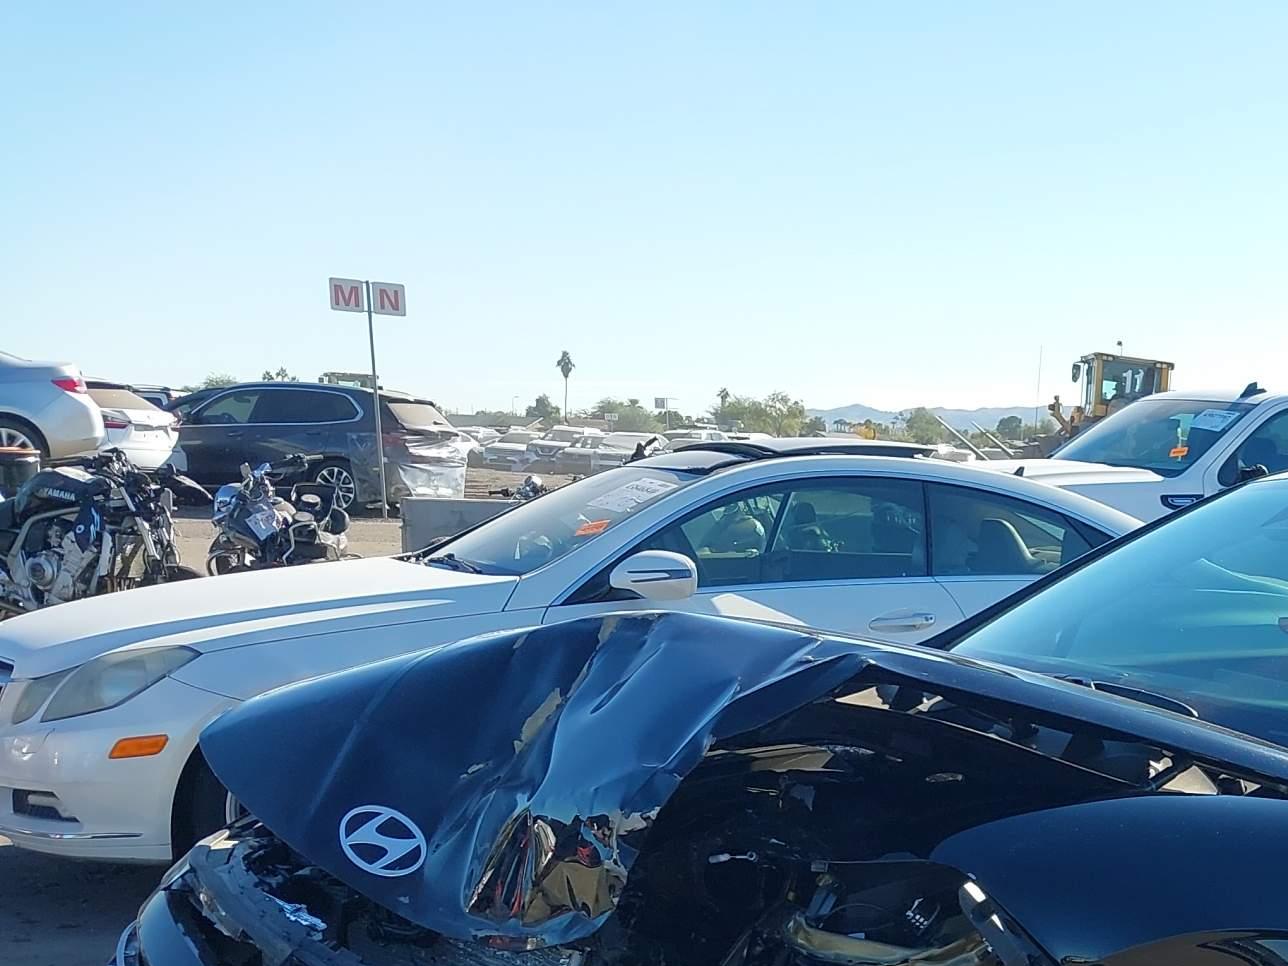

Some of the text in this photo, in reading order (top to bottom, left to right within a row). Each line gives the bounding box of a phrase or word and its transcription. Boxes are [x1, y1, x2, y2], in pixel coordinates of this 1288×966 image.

[333, 284, 360, 308] M
[379, 288, 400, 311] N
[1122, 369, 1145, 393] 11
[42, 487, 76, 501] YAMAHA
